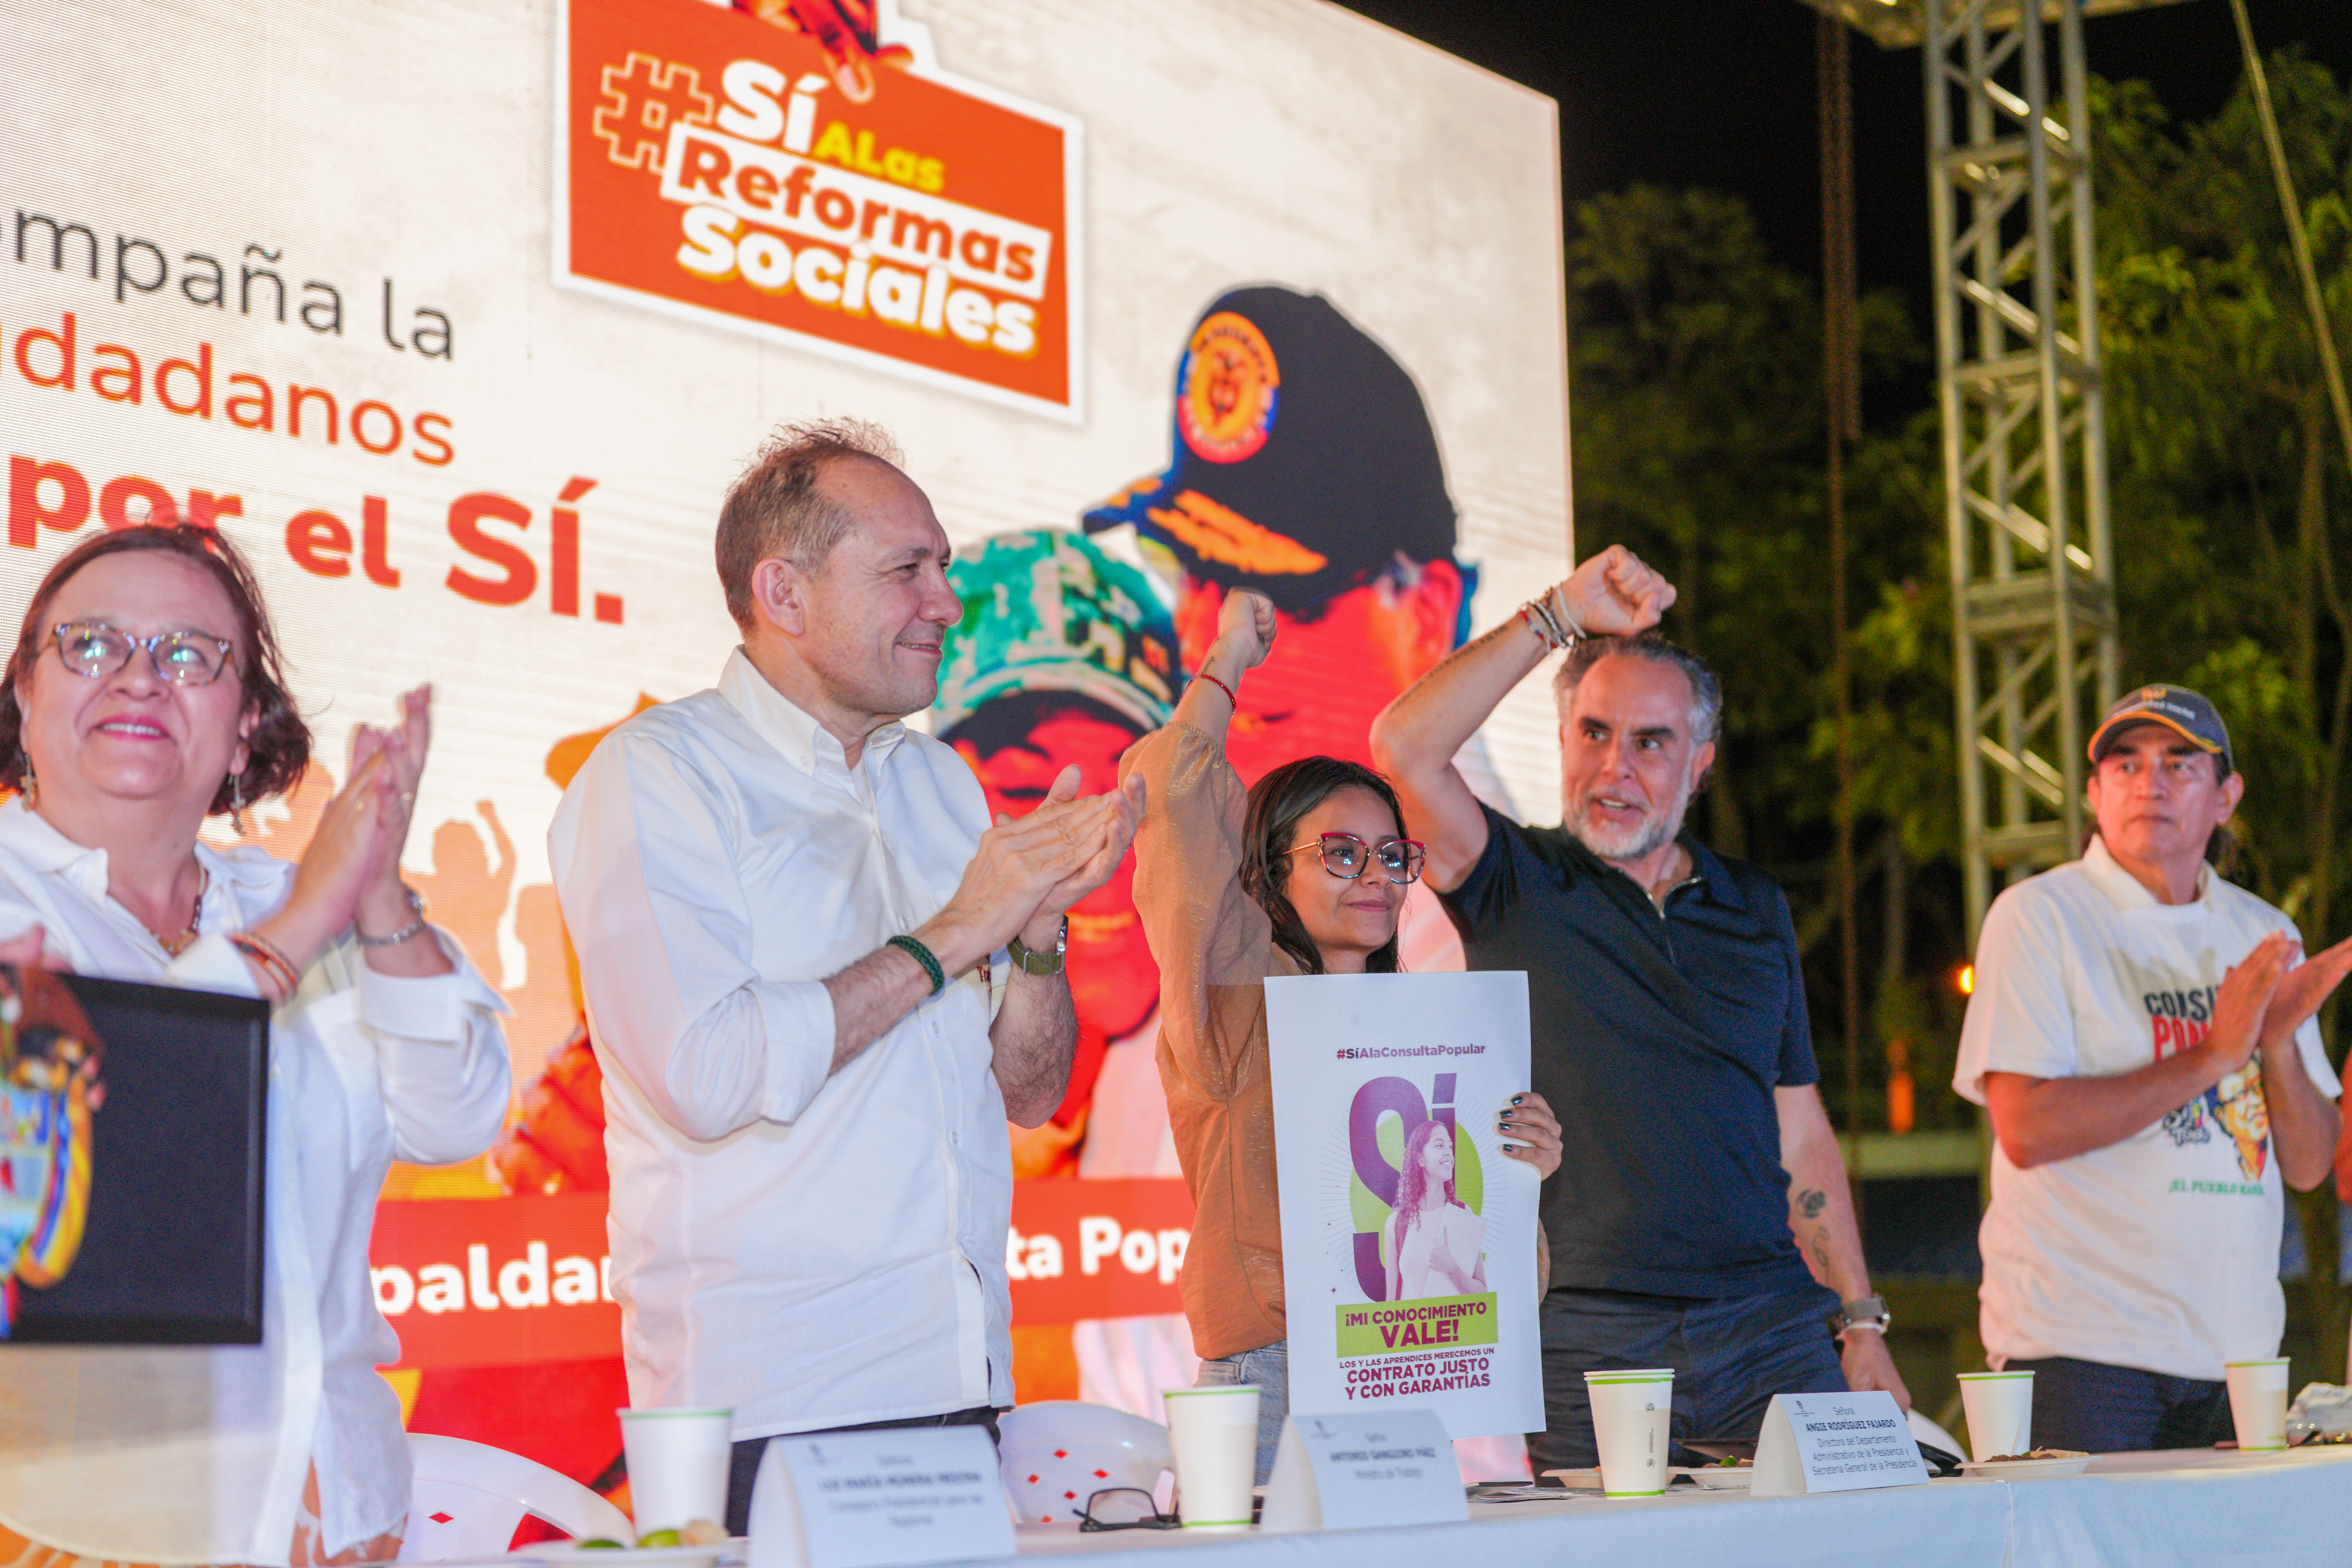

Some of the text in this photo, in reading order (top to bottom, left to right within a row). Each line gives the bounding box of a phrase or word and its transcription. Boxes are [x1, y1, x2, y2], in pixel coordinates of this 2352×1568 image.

[678, 133, 1037, 283] Reformas
[0, 207, 455, 362] mpaña la
[676, 204, 1040, 360] Sociales
[0, 311, 456, 468] dadanos
[7, 454, 625, 626] por el Sí.
[1337, 1043, 1486, 1060] #SíAlaConsultaPopular
[1345, 1302, 1487, 1326] ¡MI CONOCIMIENTO
[1380, 1319, 1459, 1348] VALE!
[1340, 1361, 1356, 1369] LOS
[1366, 1358, 1382, 1366] LAS
[1383, 1353, 1432, 1365] APRENDICES
[1434, 1349, 1482, 1360] MERECEMOS
[1347, 1357, 1490, 1384] CONTRATO JUSTO
[1345, 1371, 1491, 1400] Y CON GARANTÍAS
[1833, 1406, 1855, 1415] Señora
[1805, 1418, 1896, 1432] ANGIE RODRÍGUEZ FAJARDO
[1813, 1452, 1856, 1461] Administrativo
[1857, 1450, 1865, 1458] de
[1866, 1449, 1872, 1458] la
[1871, 1447, 1905, 1457] Presidencia
[1817, 1435, 1897, 1448] Directora del Departamento
[1845, 1462, 1868, 1473] General
[1870, 1461, 1877, 1470] de
[1878, 1461, 1884, 1470] la
[1884, 1459, 1917, 1469] Presidencia
